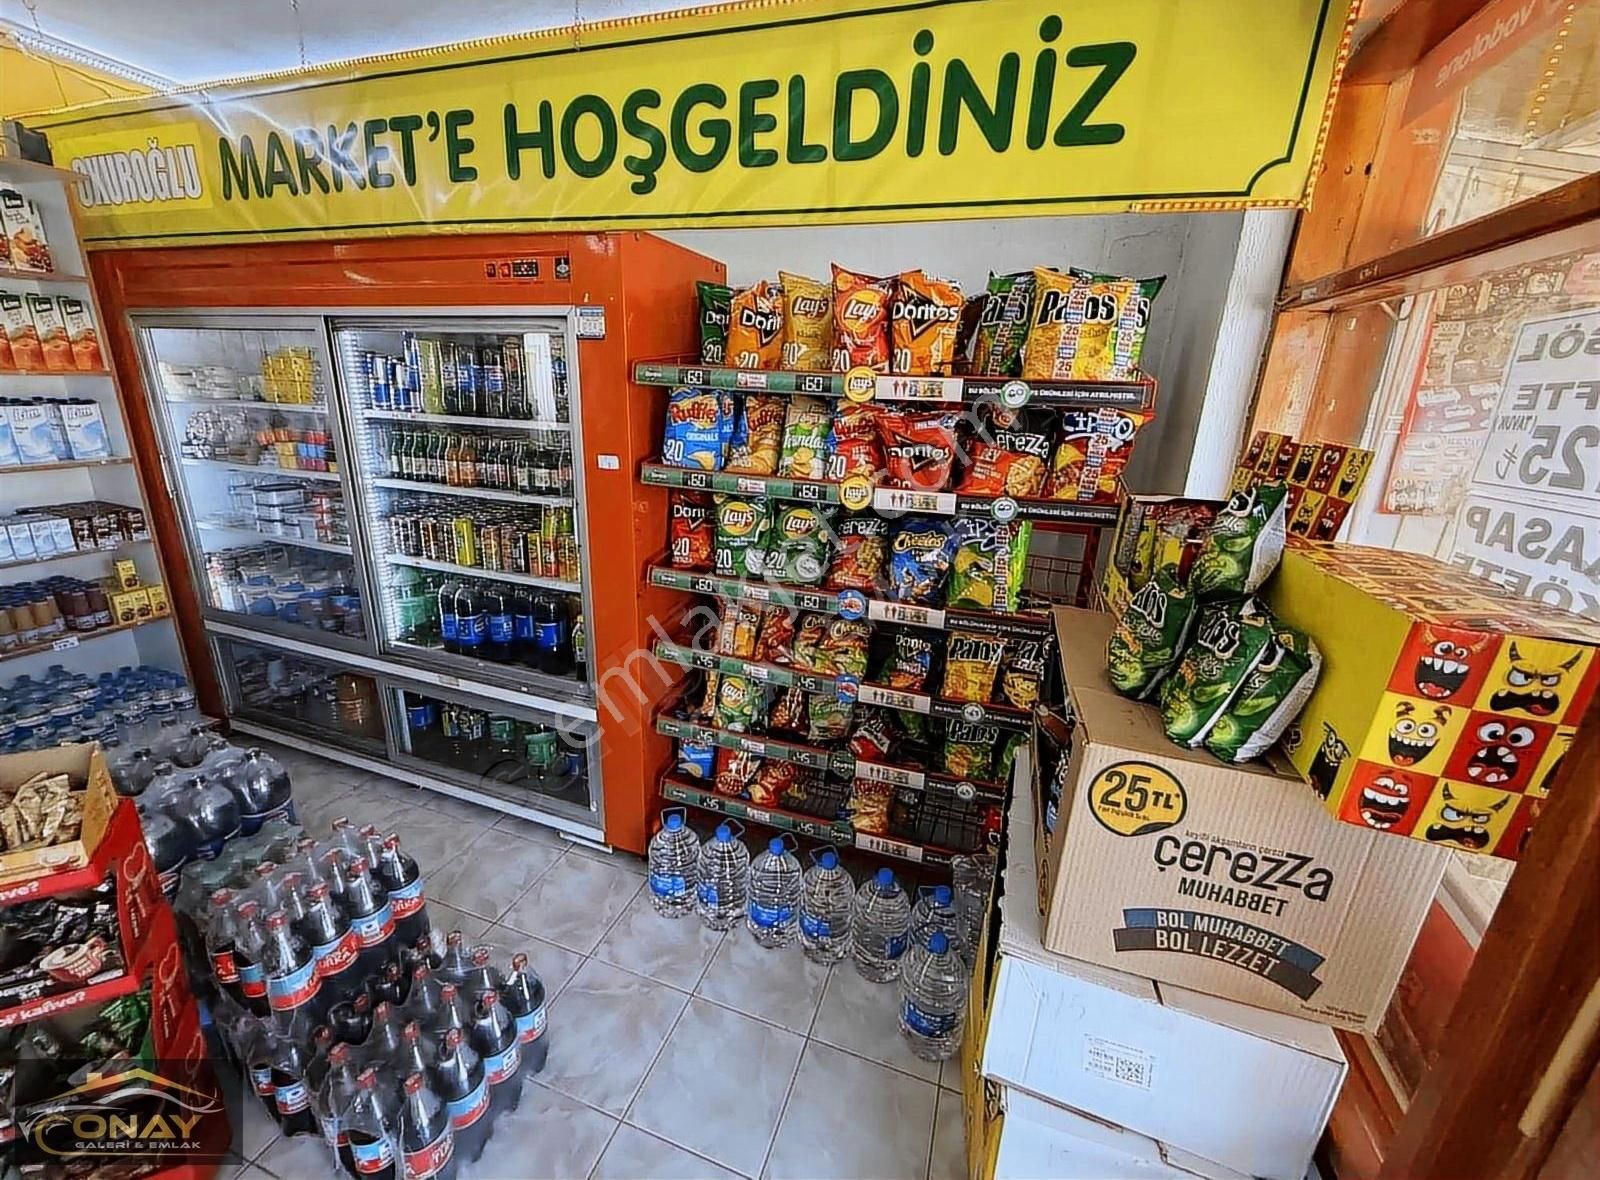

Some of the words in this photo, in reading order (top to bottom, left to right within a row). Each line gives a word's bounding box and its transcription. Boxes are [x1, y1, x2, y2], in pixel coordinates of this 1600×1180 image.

[218, 109, 478, 200] MARKET'E
[503, 14, 1138, 196] HOŞGELDİNİZ
[794, 296, 828, 318] Lay's
[892, 302, 960, 320] Doritos
[1034, 289, 1118, 325] Paos
[996, 432, 1050, 458] erezza
[723, 509, 754, 528] Lay's
[785, 515, 817, 535] Lay's
[893, 530, 945, 550] Cheetos
[1099, 770, 1152, 812] 25
[1177, 876, 1289, 918] MUHABBET
[1156, 910, 1190, 931] BOL
[1192, 913, 1291, 957] MUHABBET
[1155, 930, 1196, 952] BOL
[1201, 934, 1281, 977] LEZZET
